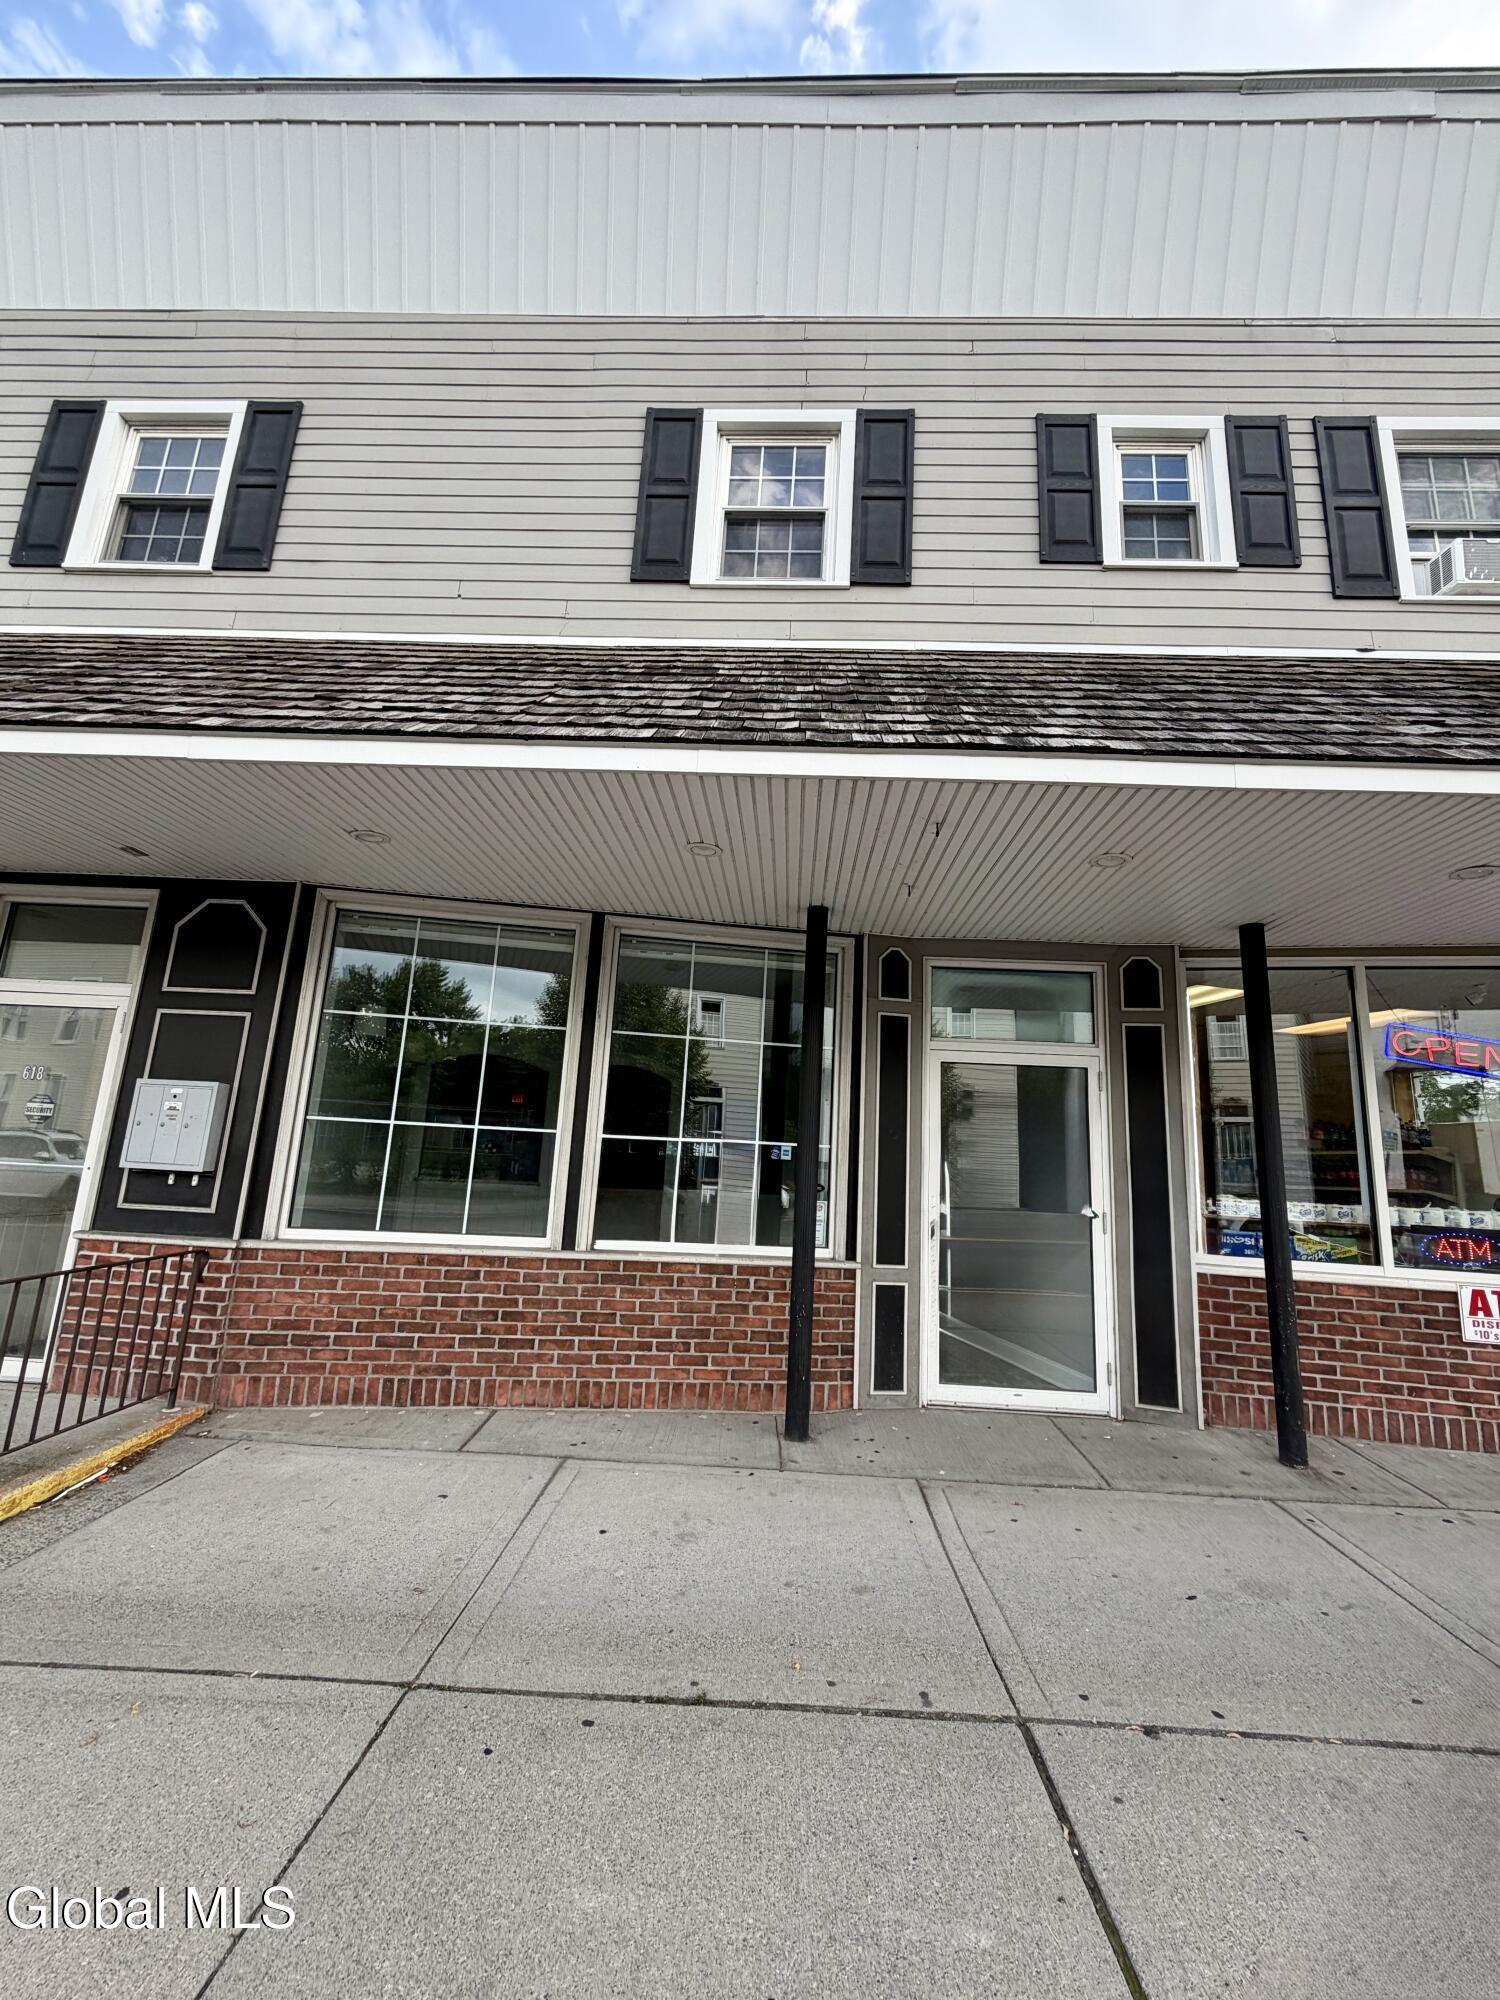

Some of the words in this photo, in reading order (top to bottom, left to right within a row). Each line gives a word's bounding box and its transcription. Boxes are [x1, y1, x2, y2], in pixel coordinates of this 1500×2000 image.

[22, 1065, 45, 1080] 618
[25, 1106, 53, 1115] SECURITY
[1436, 1238, 1492, 1264] ATM
